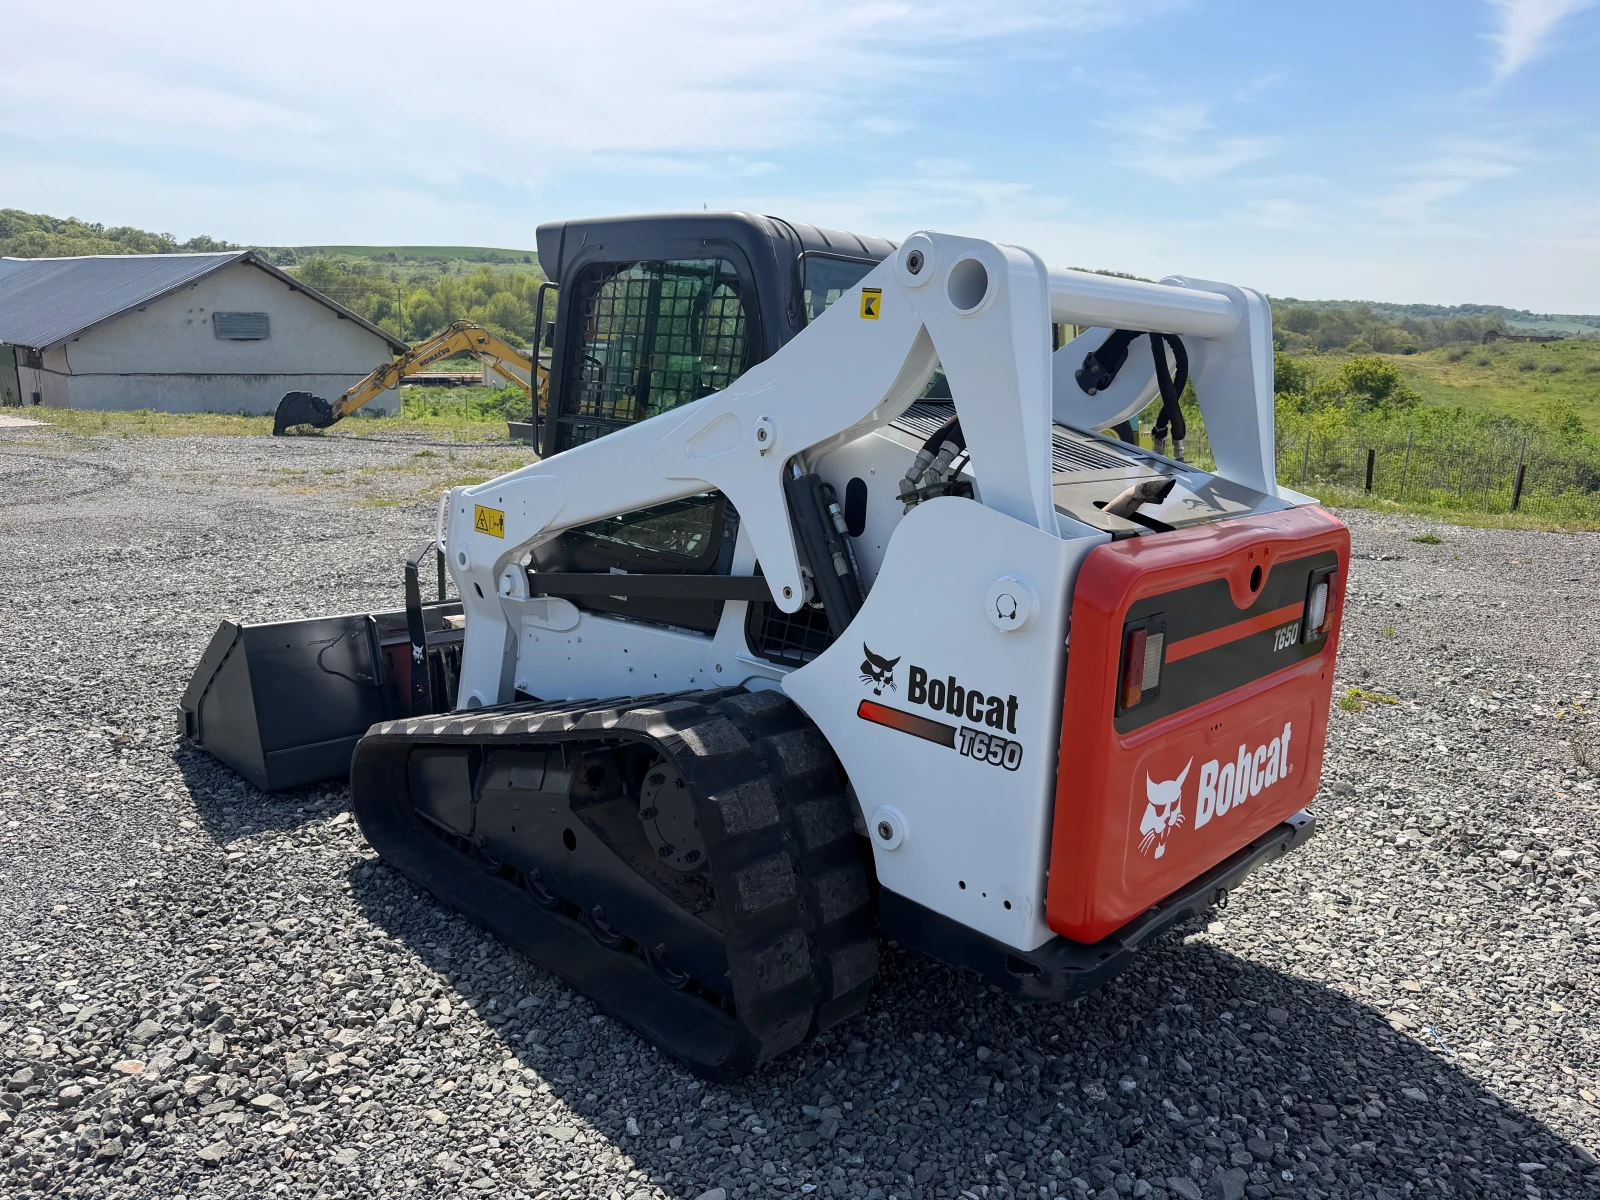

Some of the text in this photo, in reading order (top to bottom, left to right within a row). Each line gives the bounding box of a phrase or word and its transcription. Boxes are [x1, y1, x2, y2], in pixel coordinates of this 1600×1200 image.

[419, 347, 450, 367] KOMATSU
[1273, 622, 1299, 652] T650
[907, 664, 1019, 735] Bobcat
[959, 725, 1023, 771] T650
[1194, 721, 1292, 831] Bobcat
